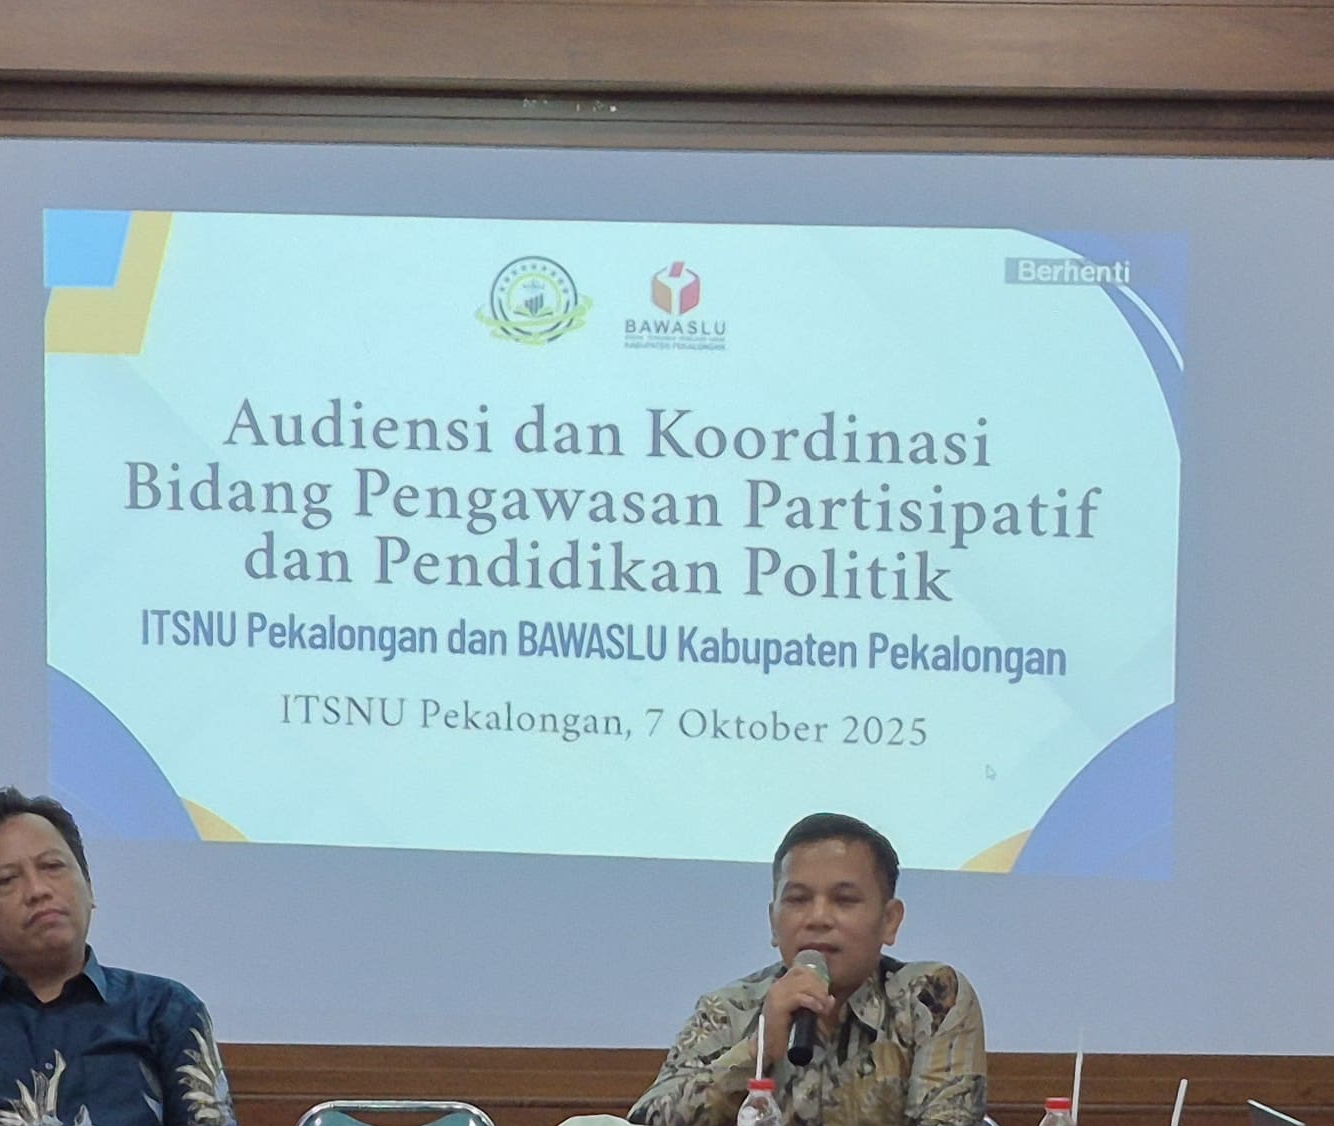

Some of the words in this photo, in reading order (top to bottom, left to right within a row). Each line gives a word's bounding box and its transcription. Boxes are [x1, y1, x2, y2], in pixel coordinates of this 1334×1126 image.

[1018, 259, 1130, 283] Berhenti
[624, 319, 726, 335] BAWASLU
[222, 397, 493, 453] Audiensi
[515, 403, 624, 456] dan
[645, 408, 992, 467] Koordinasi
[124, 461, 333, 530] Bidang
[354, 467, 723, 535] Pengawasan
[742, 478, 1103, 550] Partisipatif
[244, 530, 353, 583] dan
[374, 535, 722, 595] Pendidikan
[743, 546, 954, 602] Politik
[141, 608, 237, 648] ITSNU
[247, 612, 438, 662] Pekalongan
[447, 618, 507, 656] dan
[518, 620, 667, 662] BAWASLU
[678, 625, 857, 674] Kabupaten
[868, 632, 1067, 685] Pekalongan
[280, 693, 407, 728] ITSNU
[420, 698, 632, 742] Pekalongan,
[645, 708, 665, 738] 7
[678, 709, 828, 743] Oktober
[842, 715, 927, 746] 2025
